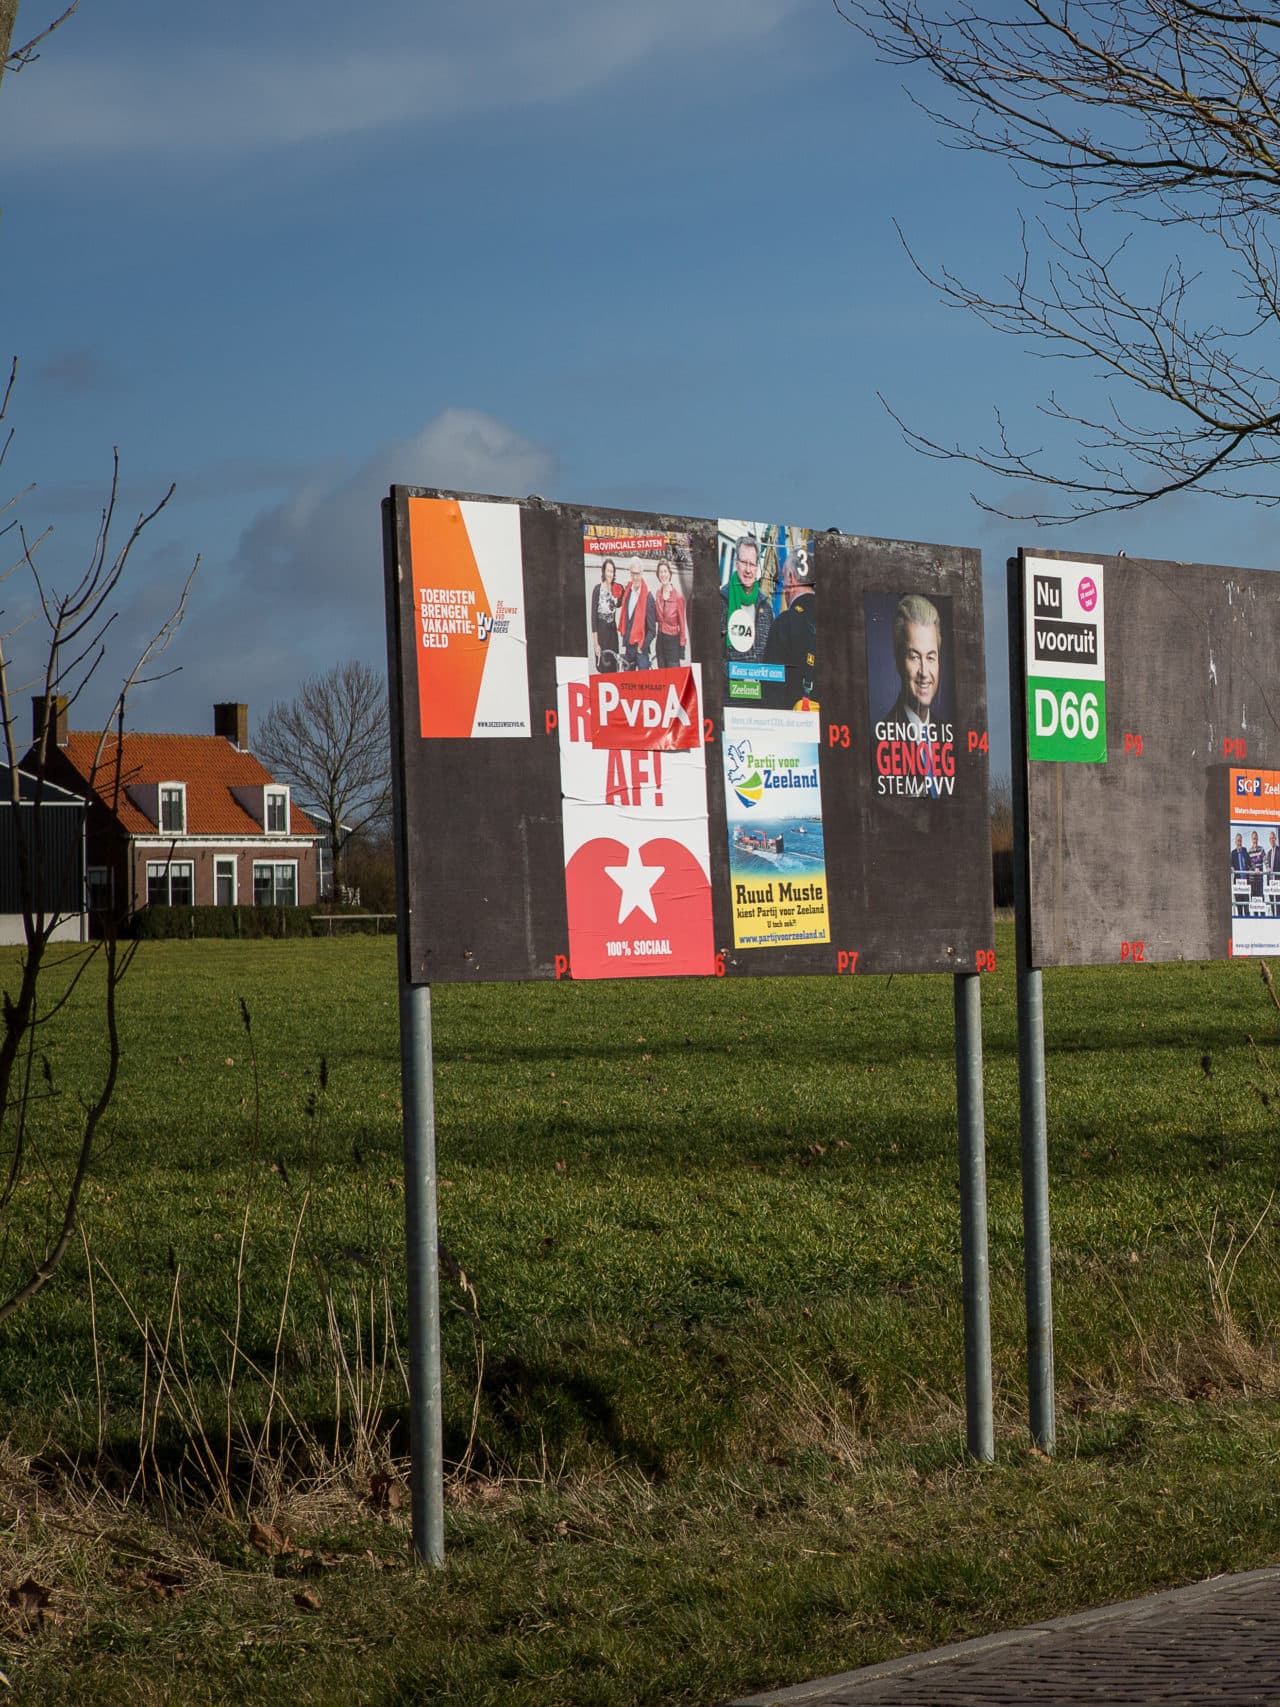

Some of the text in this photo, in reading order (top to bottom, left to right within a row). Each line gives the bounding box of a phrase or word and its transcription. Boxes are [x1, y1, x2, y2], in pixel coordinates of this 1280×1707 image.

[589, 539, 662, 551] PROVINCIALE STATEN
[797, 549, 809, 577] 3
[420, 588, 475, 605] TOERISTEN
[1037, 581, 1060, 607] Nu
[421, 604, 468, 619] BRENGEN
[422, 618, 476, 634] VAKANTIE-
[423, 634, 449, 648] GELD
[1037, 629, 1095, 654] vooruit
[1035, 689, 1099, 740] D66
[875, 722, 954, 743] GENOEG IS
[1125, 733, 1143, 756] P9
[1223, 737, 1246, 759] P10
[746, 754, 800, 771] Partij voor
[876, 741, 955, 776] GENOEG
[605, 749, 664, 807] AF!
[763, 768, 818, 789] Zeeland
[878, 775, 955, 795] STEM PVV
[1238, 778, 1260, 793] SGP
[736, 882, 823, 905] Ruud Muste
[737, 904, 824, 919] kiest Partij voor Zeeland
[606, 939, 672, 957] 100% SOCIAAL
